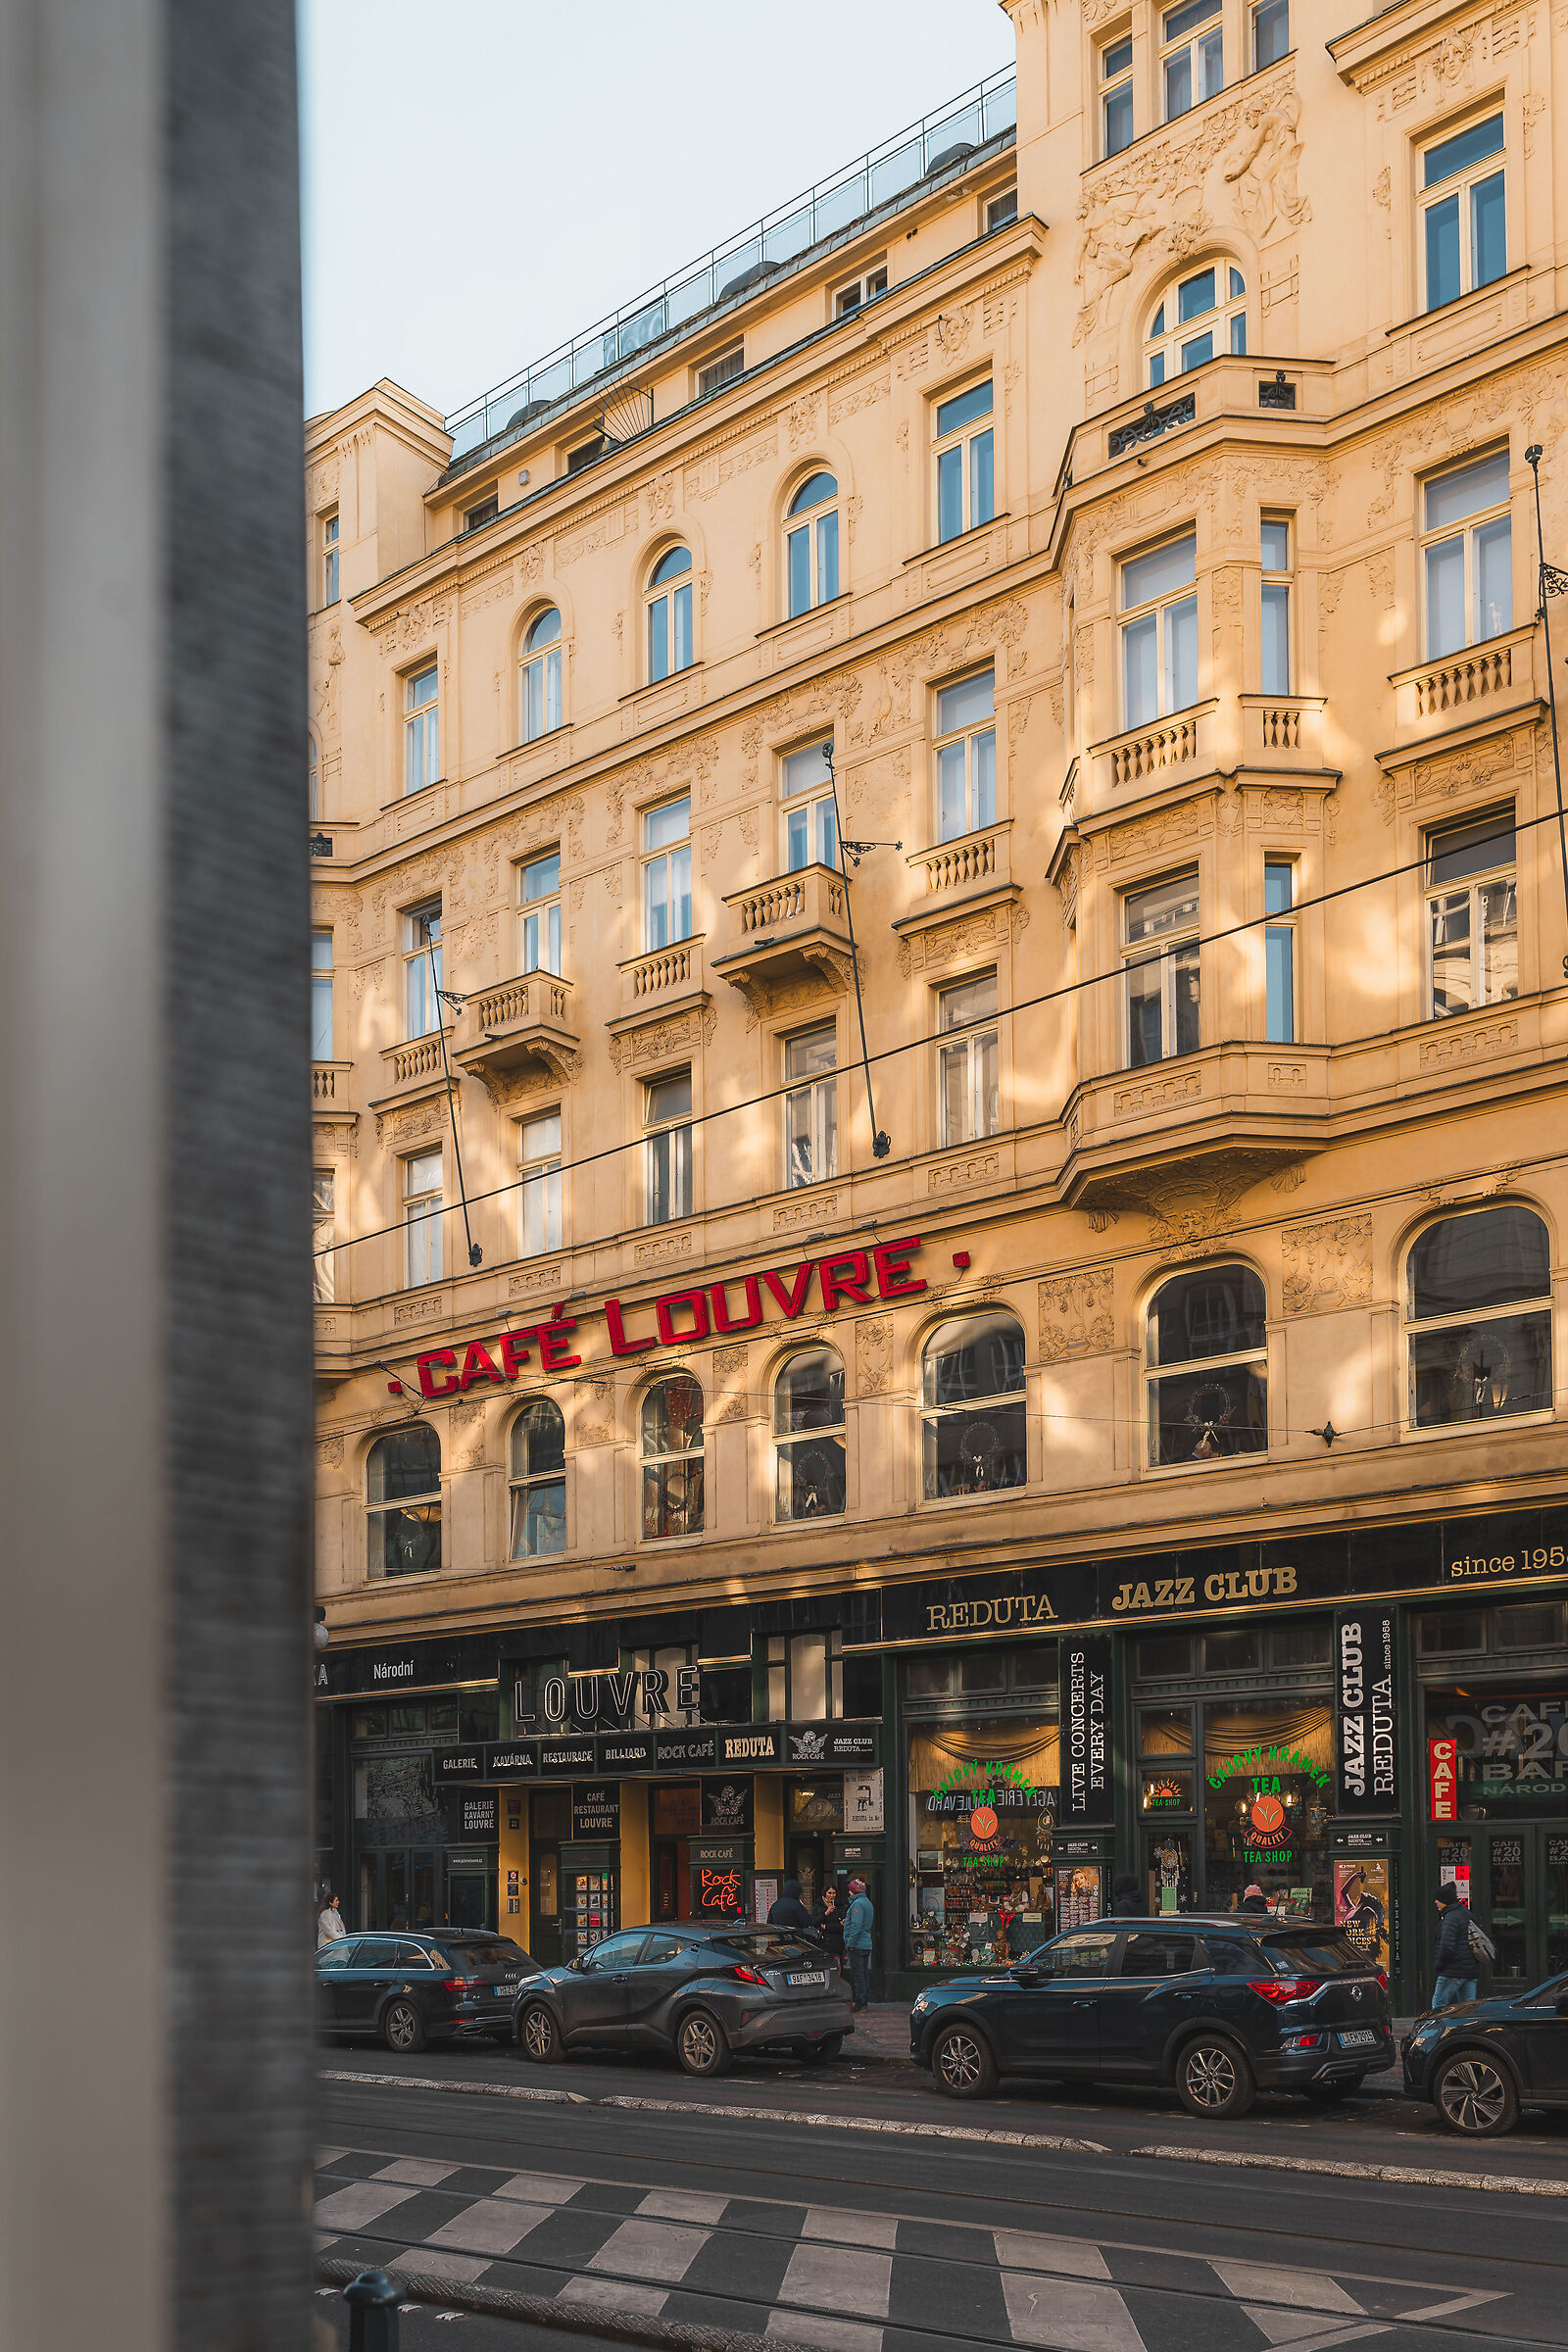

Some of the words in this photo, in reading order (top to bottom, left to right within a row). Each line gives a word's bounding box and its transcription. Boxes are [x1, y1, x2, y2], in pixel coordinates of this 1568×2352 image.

[417, 1301, 582, 1398] CAFÉ
[605, 1237, 928, 1357] LOUVRE
[1450, 1555, 1515, 1578] since
[1521, 1545, 1568, 1571] 195
[1111, 1577, 1196, 1611] JAZZ
[1204, 1566, 1298, 1601] CLUB
[926, 1594, 1058, 1631] REDUTA
[1382, 1619, 1391, 1643] 1958
[315, 1664, 328, 1686] A
[373, 1659, 414, 1680] Národní
[1341, 1622, 1364, 1708] CLUB
[514, 1665, 701, 1725] LOUVRE
[1091, 1671, 1104, 1714] DAY
[1070, 1651, 1085, 1758] CONCERTS
[1481, 1701, 1568, 1723] CAF
[1371, 1674, 1394, 1795] REDUTA
[542, 1750, 594, 1764] RESTAURACE
[605, 1746, 647, 1761] BILLIARD
[658, 1743, 686, 1760] ROCK
[688, 1740, 714, 1758] CAFÉ
[724, 1736, 775, 1758] REDUTA
[809, 1751, 825, 1760] CAFÉ
[1091, 1719, 1104, 1789] EVERY
[1344, 1715, 1366, 1796] JAZZ
[443, 1757, 477, 1770] GALERIE
[493, 1752, 533, 1768] KAVÁRNA
[1205, 1742, 1261, 1789] ČAJOVÝ
[1269, 1744, 1331, 1788] KRÁMEK
[930, 1758, 978, 1801] ČAJOVÝ
[986, 1760, 1039, 1799] KRÁMEK
[1071, 1763, 1085, 1812] LIVE
[1251, 1777, 1281, 1794] TEA
[1433, 1741, 1453, 1819] CAFE
[464, 1800, 494, 1811] GALERIE
[586, 1790, 606, 1802] CAFÉ
[970, 1788, 997, 1805] TEA
[464, 1809, 495, 1820] KAVÁRNY
[574, 1804, 619, 1815] RESTAURANT
[464, 1819, 495, 1830] LOUVRE
[580, 1817, 613, 1829] LOUVRE
[1250, 1831, 1285, 1845] QUALITY
[700, 1849, 717, 1859] ROCK
[717, 1847, 734, 1858] CAFÉ
[1243, 1850, 1261, 1863] TEA
[1265, 1850, 1293, 1862] SHOP
[1442, 1847, 1468, 1857] #20
[1493, 1846, 1521, 1856] #20
[963, 1857, 979, 1868] TEA
[981, 1856, 1004, 1868] SHOP
[701, 1868, 742, 1887] Rock
[702, 1886, 738, 1912] Café
[1340, 1920, 1361, 1929] NEW
